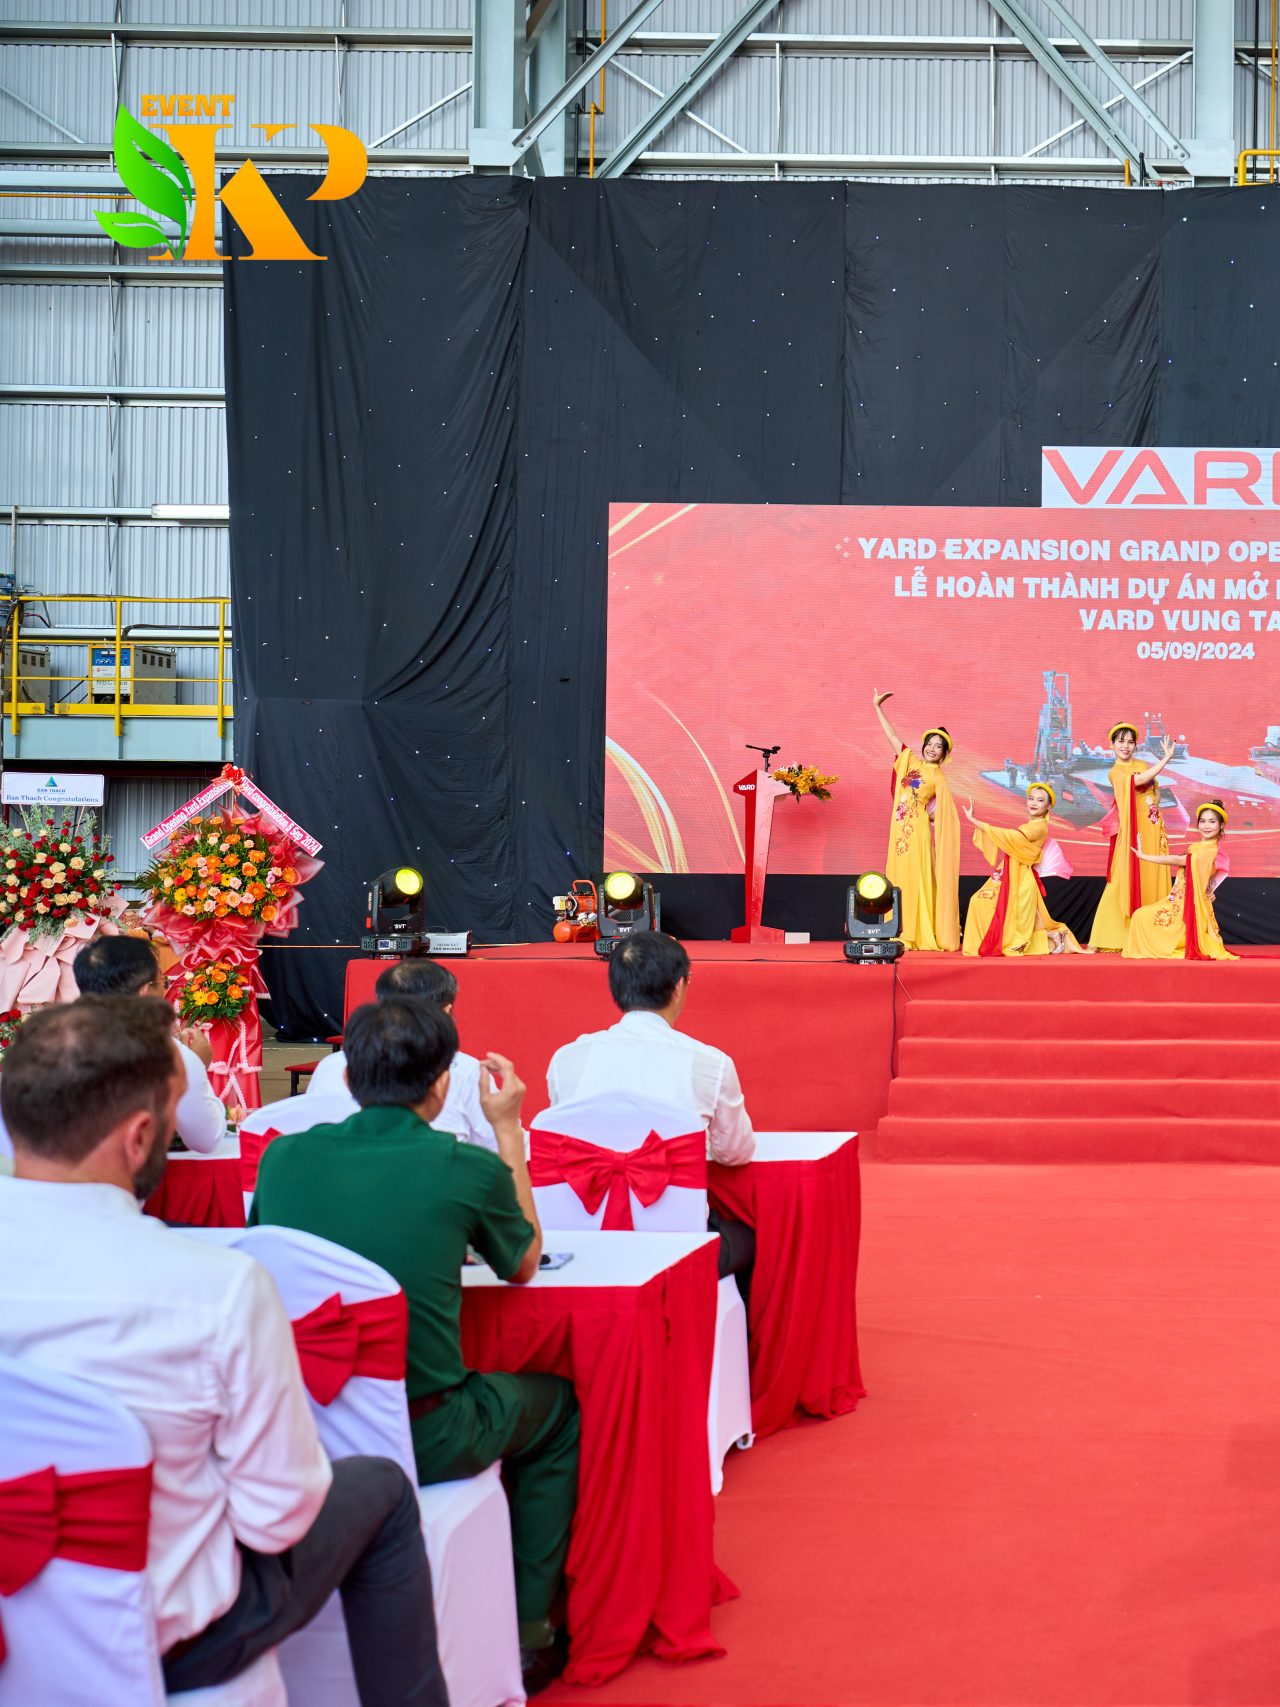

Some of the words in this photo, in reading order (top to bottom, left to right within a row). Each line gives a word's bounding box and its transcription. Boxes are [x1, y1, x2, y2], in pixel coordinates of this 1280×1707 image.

[857, 537, 937, 560] YARD
[945, 538, 1111, 561] EXPANSION
[1119, 540, 1220, 562] GRAND
[894, 565, 928, 597] LỄ
[936, 571, 1015, 598] HOÀN
[1022, 571, 1119, 599] THÀNH
[1127, 577, 1170, 605] DỰ
[1177, 572, 1216, 600] ÁN
[1224, 571, 1269, 600] MỞ
[1079, 608, 1155, 630] VARD
[1162, 609, 1241, 632] VUNG
[1136, 641, 1256, 661] 05/09/2024
[43, 795, 99, 803] Congratulations
[251, 792, 289, 829] congratulation
[144, 827, 162, 845] Grand
[161, 812, 188, 832] Opening
[182, 801, 200, 816] Yard
[285, 822, 295, 832] 5
[289, 826, 304, 841] Sep
[300, 837, 319, 853] 2024
